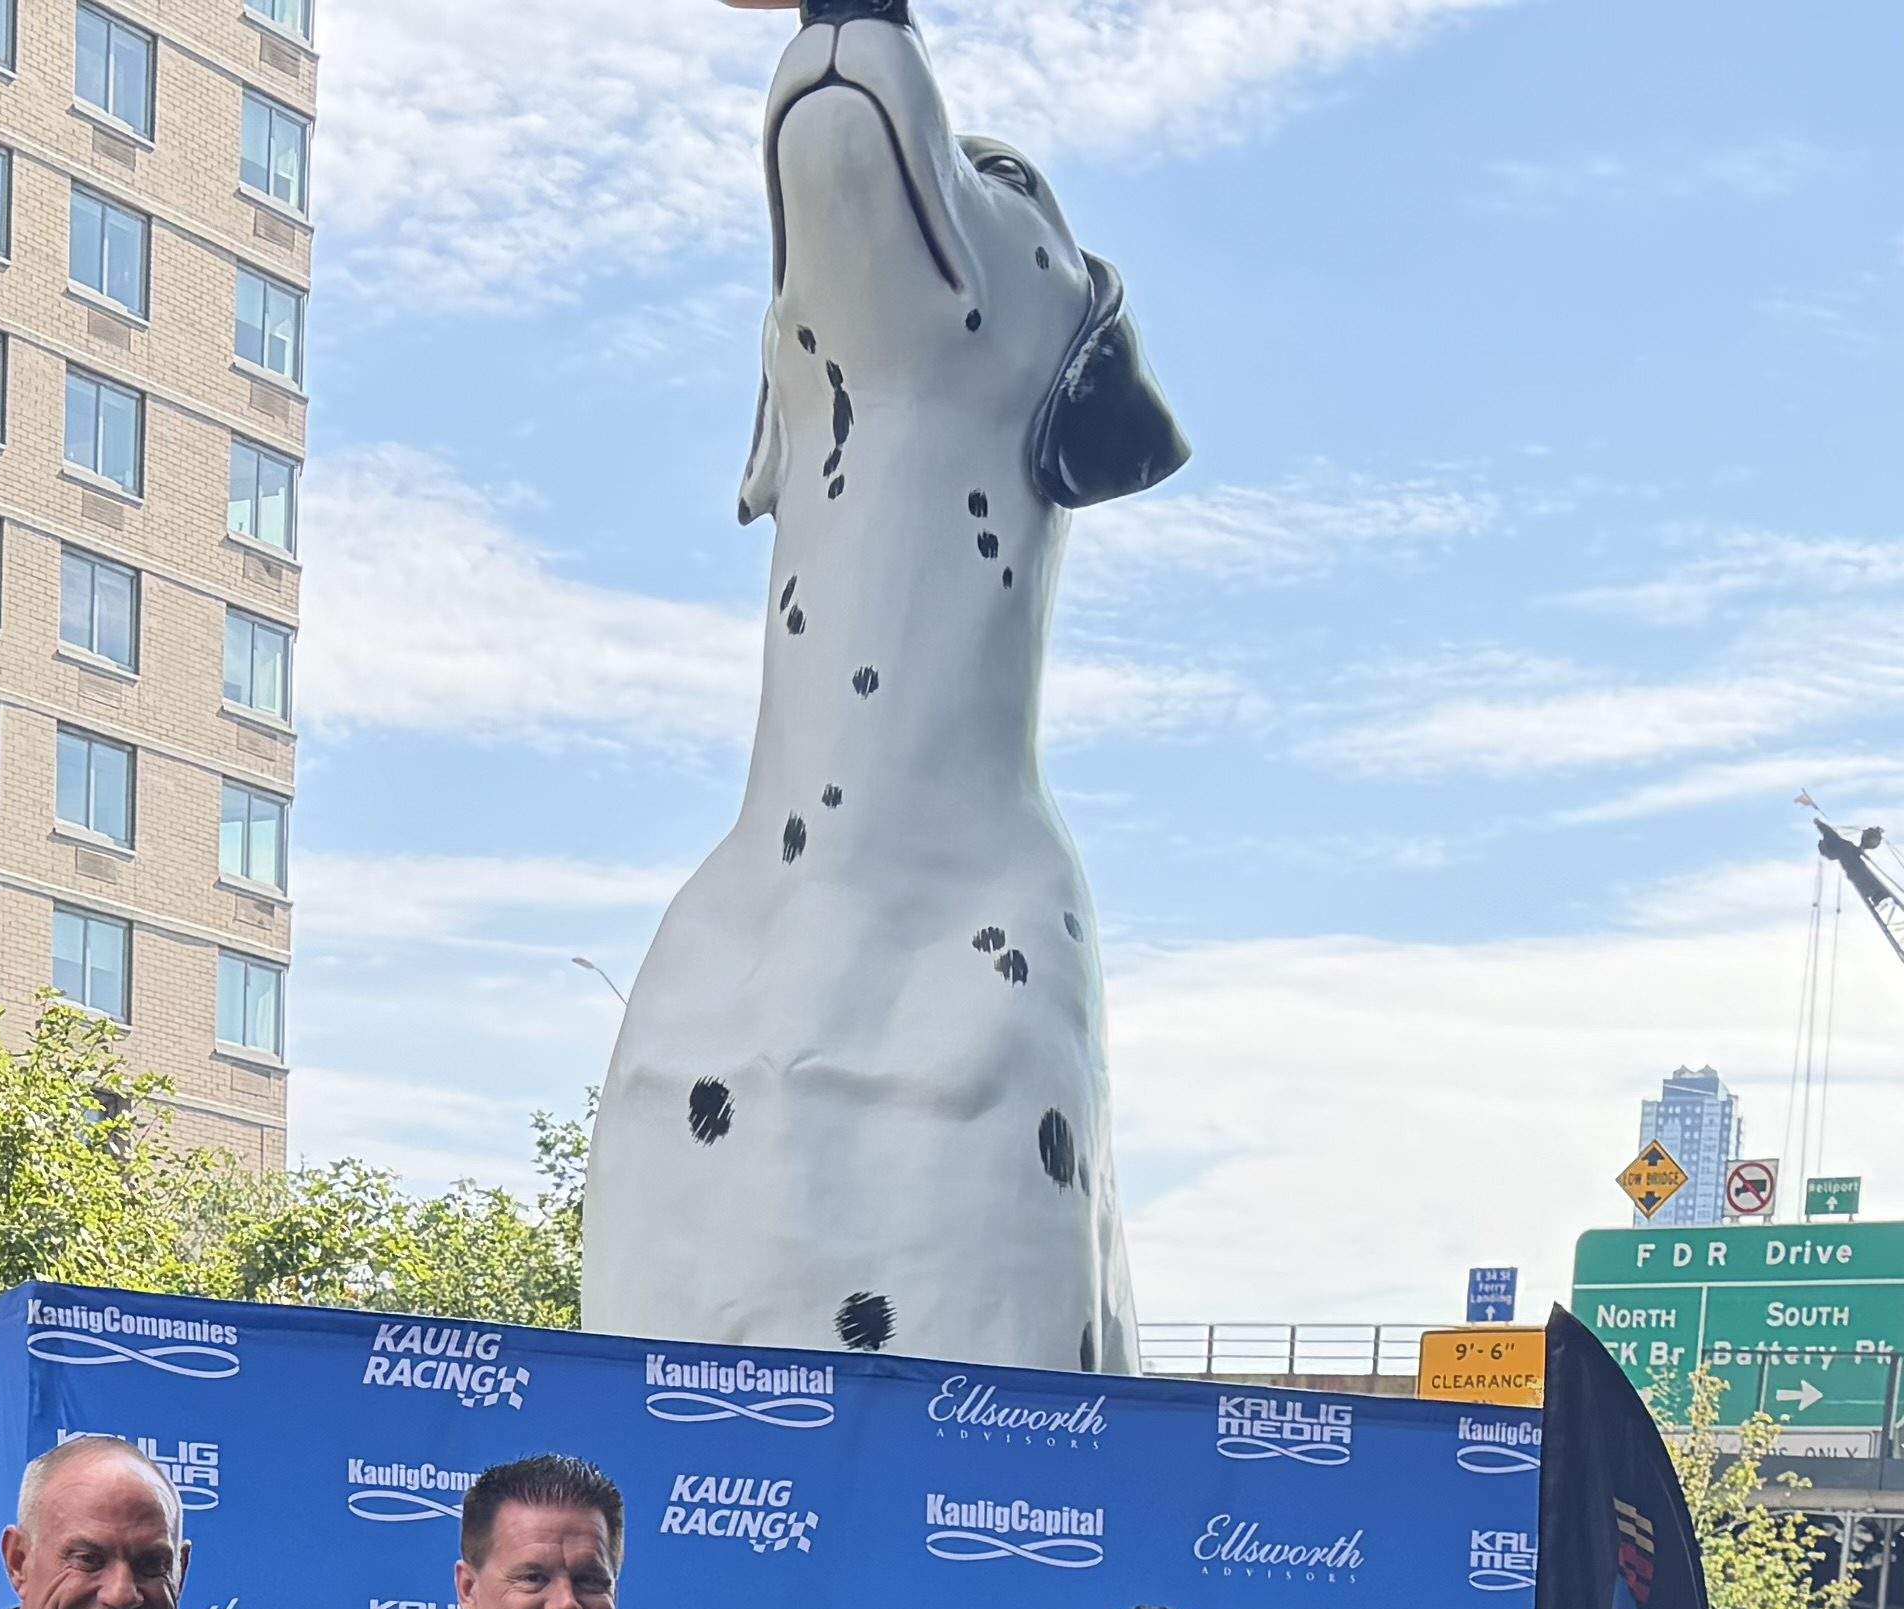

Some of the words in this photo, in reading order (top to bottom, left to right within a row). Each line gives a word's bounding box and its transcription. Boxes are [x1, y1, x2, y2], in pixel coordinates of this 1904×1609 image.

[1765, 1240, 1853, 1266] Drive
[27, 1299, 238, 1347] KauligCompanies
[373, 1324, 502, 1359] KAULIG
[1649, 1341, 1686, 1366] Br
[1712, 1340, 1838, 1371] Battery
[362, 1355, 496, 1393] RACING
[646, 1354, 834, 1396] KauligCapital
[927, 1375, 1107, 1436] Ellsworth
[1217, 1396, 1353, 1426] KAULIG
[937, 1429, 1099, 1450] ADVISORS
[1216, 1417, 1352, 1445] MEDIA
[1458, 1417, 1542, 1446] KauligCo
[348, 1458, 482, 1491] KauligCom
[669, 1474, 793, 1508] KAULIG
[659, 1505, 787, 1540] RACING
[926, 1493, 1105, 1537] KauligCapital
[1193, 1514, 1364, 1570] Ellsworth
[1201, 1566, 1357, 1584] ADVISORS
